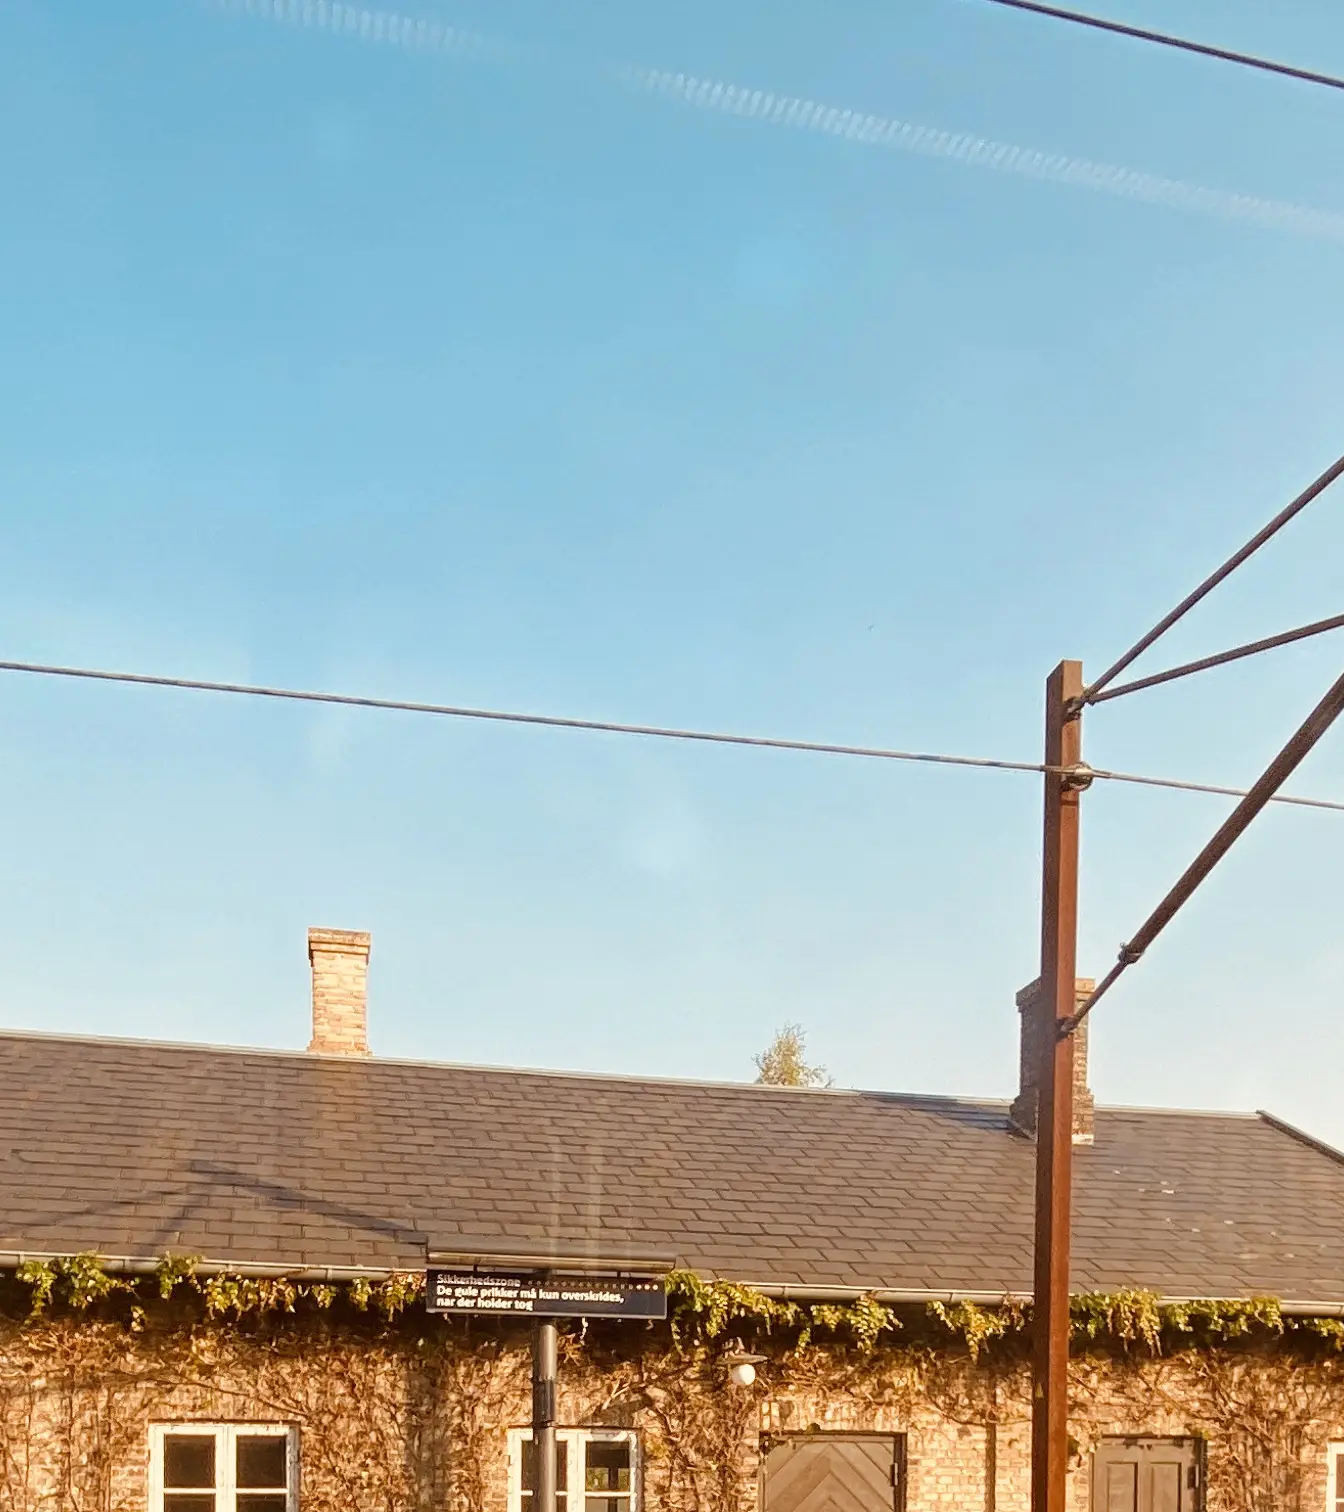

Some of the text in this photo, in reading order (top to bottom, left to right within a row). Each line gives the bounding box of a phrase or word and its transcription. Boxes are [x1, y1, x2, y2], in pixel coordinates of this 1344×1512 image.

[436, 1274, 521, 1287] Sikkerhedszone
[436, 1285, 625, 1304] De gule prikker må kun overskrides,
[456, 1297, 476, 1308] der
[477, 1298, 513, 1309] holder
[514, 1300, 534, 1312] tog
